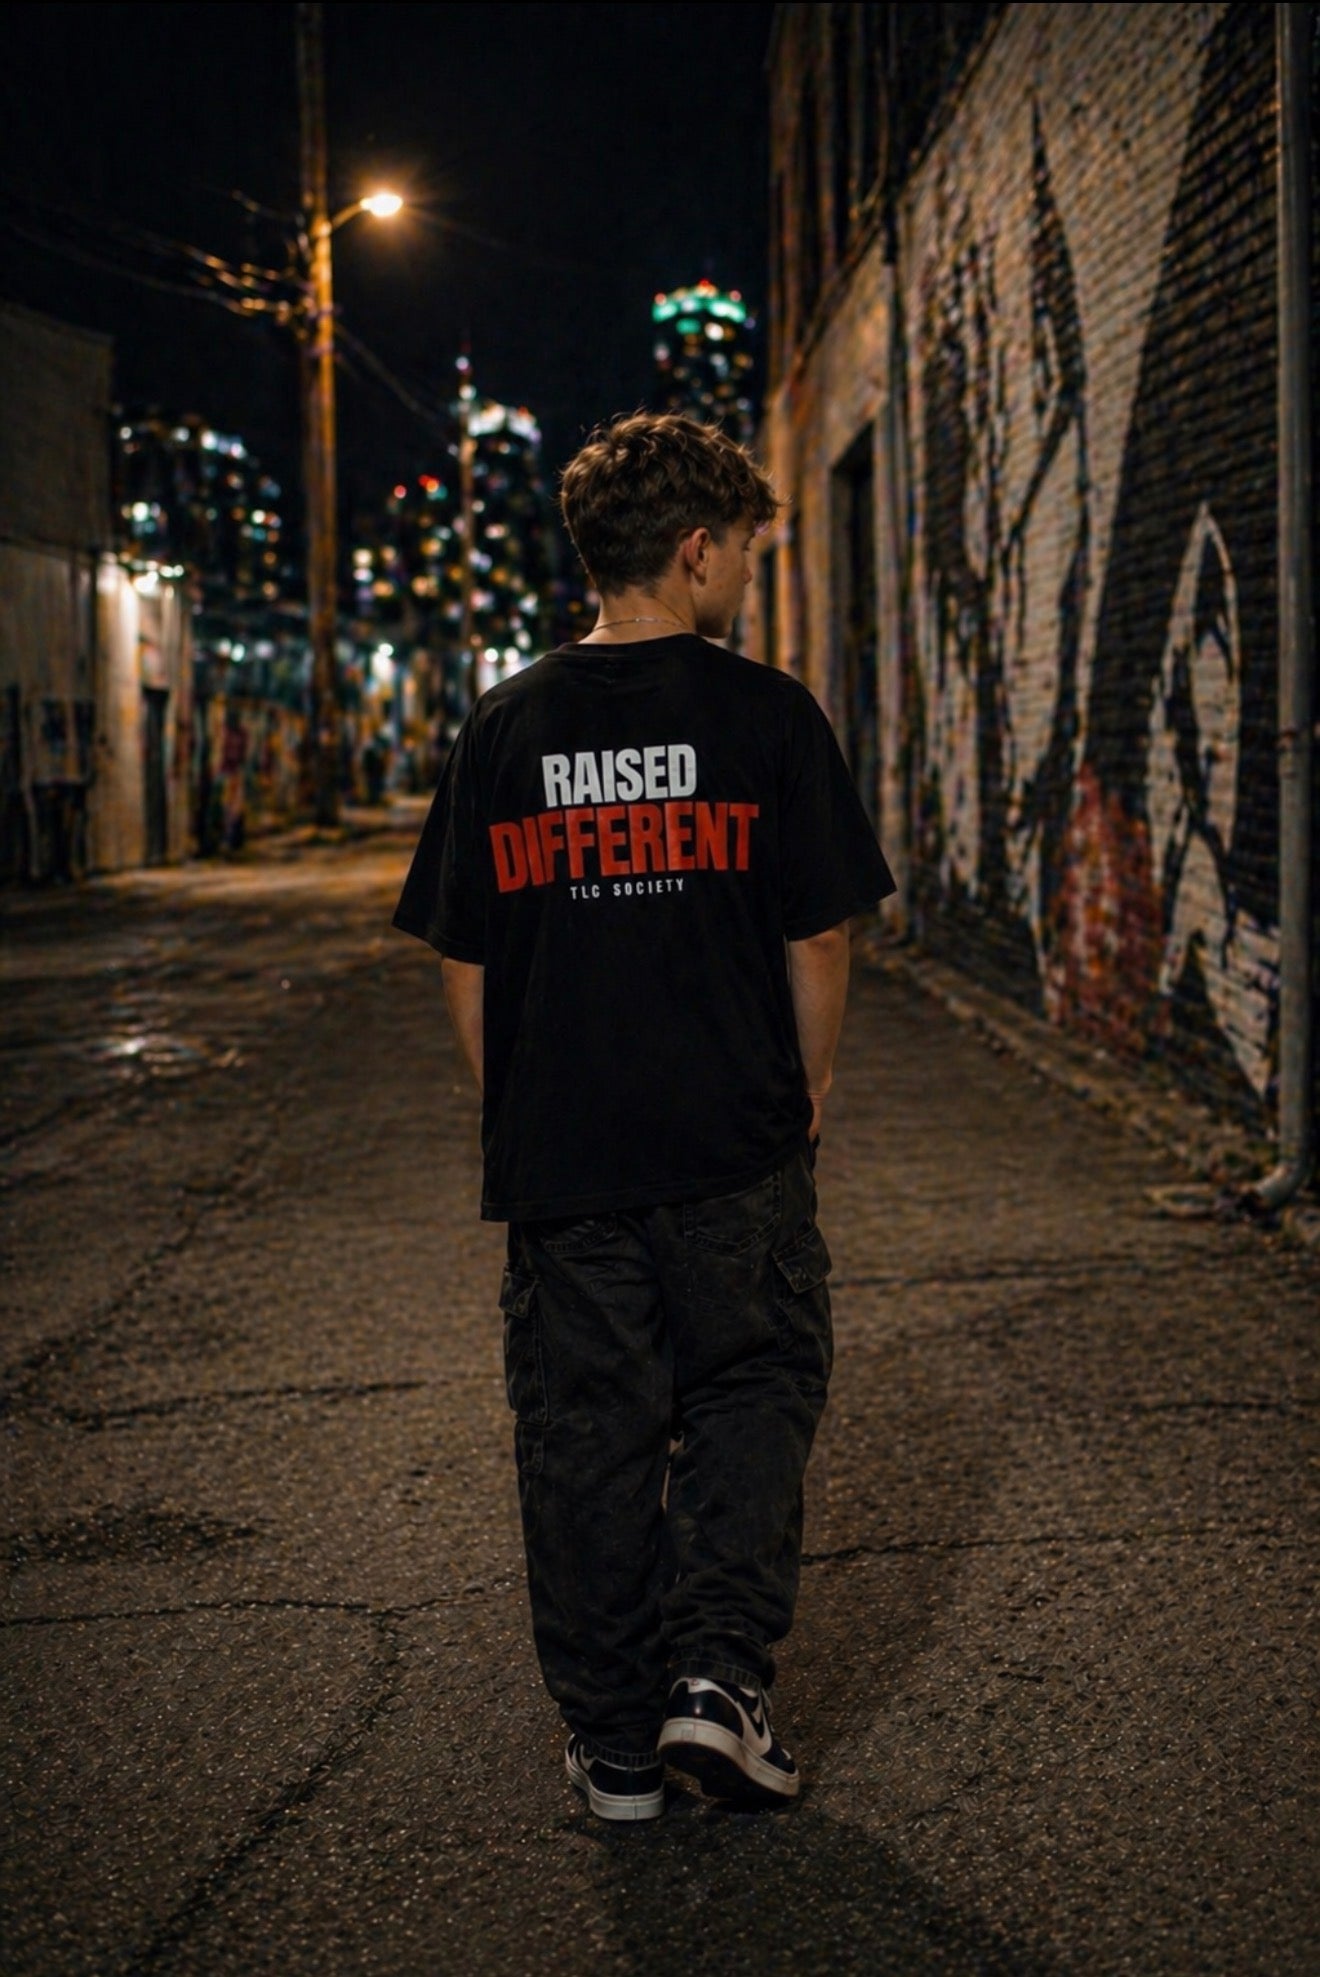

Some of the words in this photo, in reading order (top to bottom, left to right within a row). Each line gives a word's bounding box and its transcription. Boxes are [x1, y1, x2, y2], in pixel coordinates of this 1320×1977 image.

[541, 743, 697, 807] RAISED
[489, 801, 759, 893] DIFFERENT
[570, 885, 600, 900] TLC
[613, 878, 684, 897] SOCIETY
